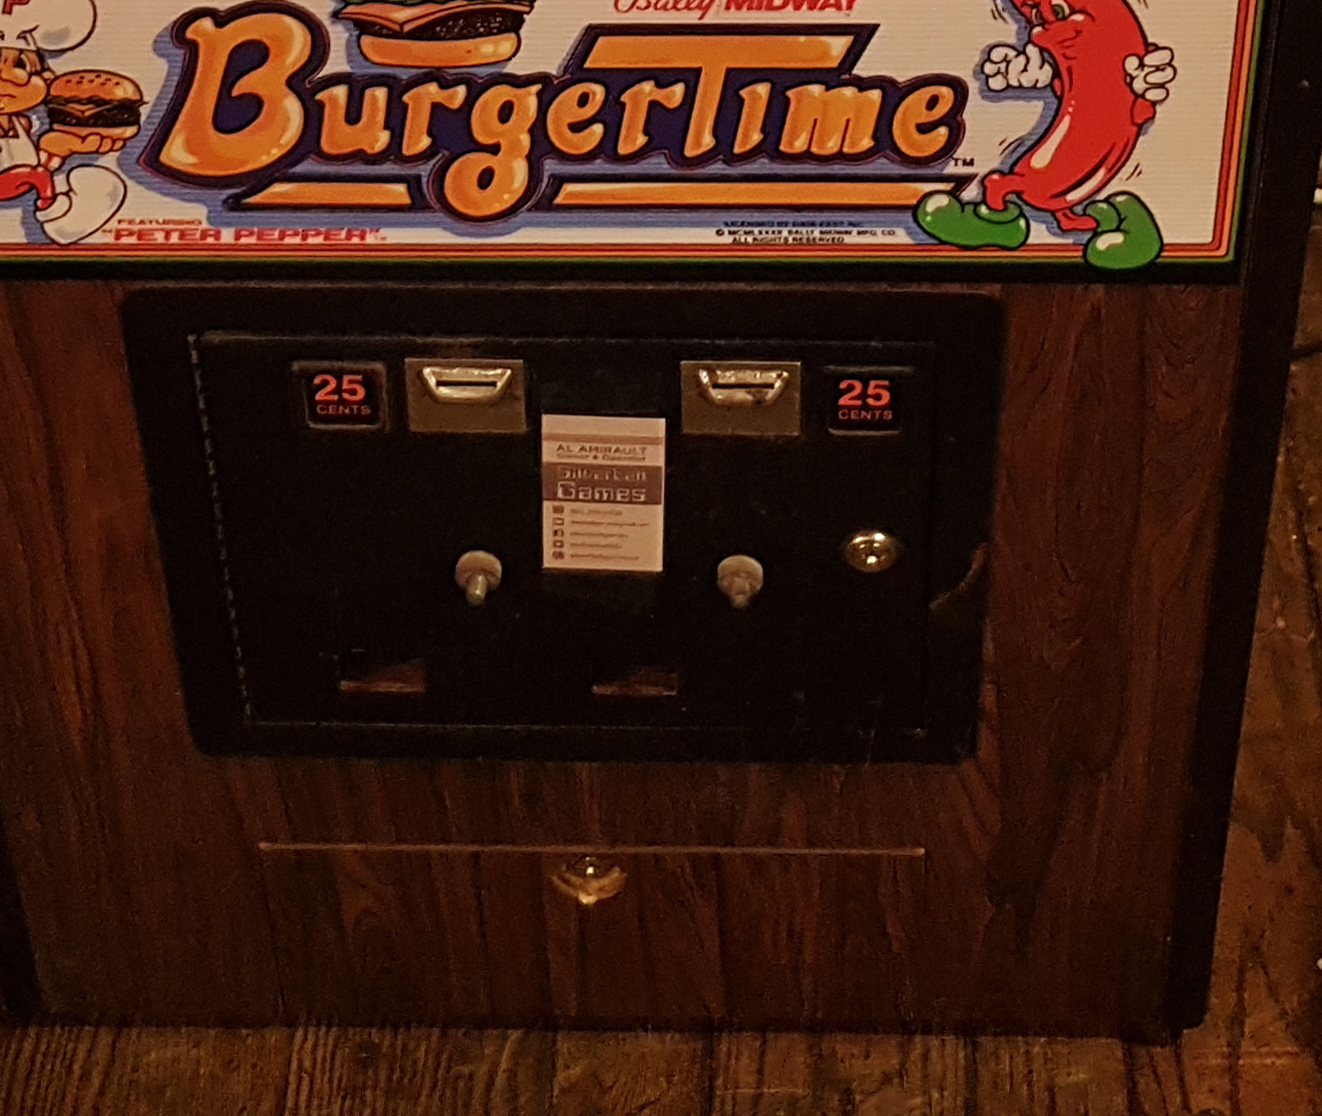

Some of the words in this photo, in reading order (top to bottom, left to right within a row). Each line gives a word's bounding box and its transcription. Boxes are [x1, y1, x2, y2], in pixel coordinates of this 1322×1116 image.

[153, 4, 961, 220] BurgerTime
[312, 373, 366, 402] 25
[837, 379, 891, 407] 25
[316, 404, 372, 415] CENTS
[838, 409, 893, 421] CENTS
[556, 444, 574, 453] AL
[557, 481, 647, 502] Games
